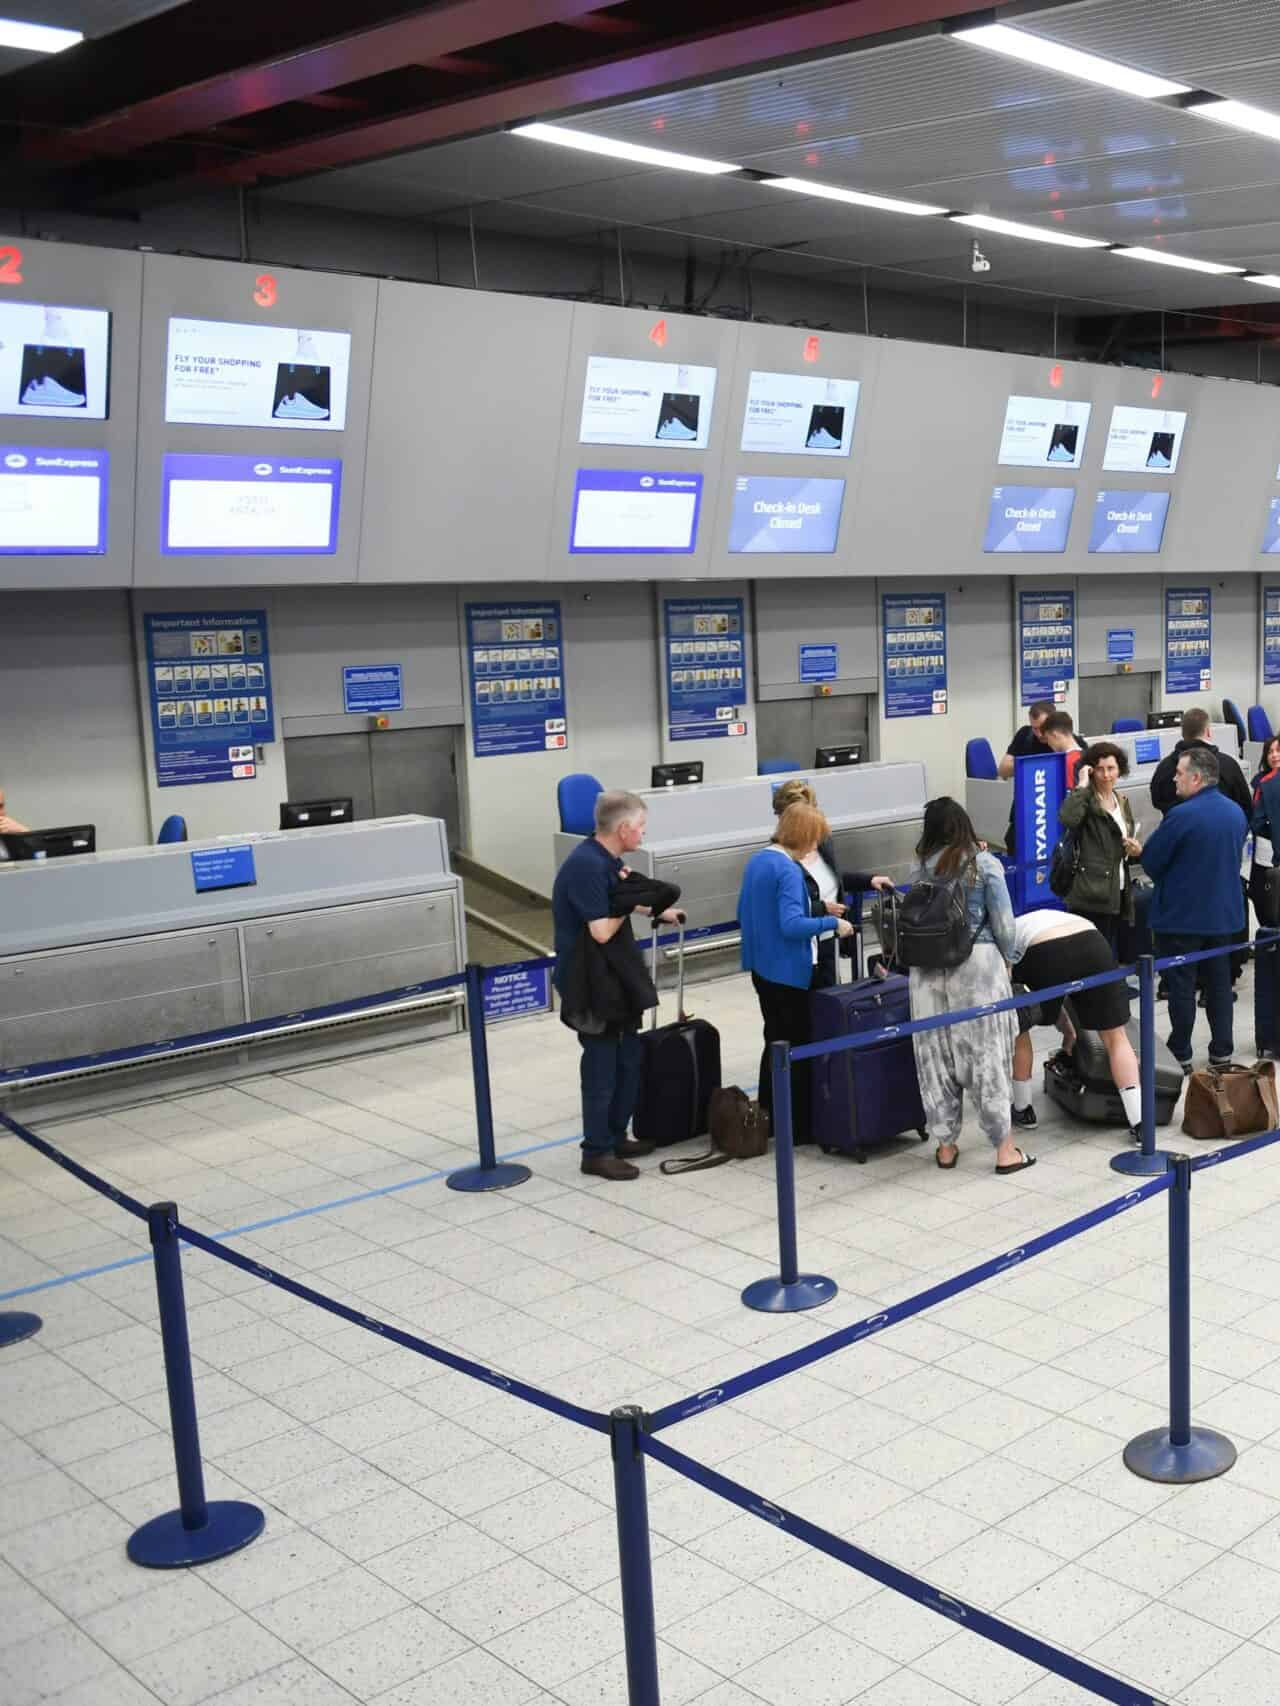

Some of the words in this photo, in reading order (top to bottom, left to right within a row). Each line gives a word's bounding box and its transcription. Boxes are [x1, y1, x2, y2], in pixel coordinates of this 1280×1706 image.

[0, 246, 23, 284] 2
[252, 274, 278, 307] 3
[649, 319, 667, 348] 4
[174, 354, 189, 362] FLY
[192, 356, 216, 365] YOUR
[218, 358, 262, 369] SHOPPING
[174, 365, 191, 373] FOR
[35, 457, 99, 468] SunExpress
[279, 465, 332, 475] SunExpress
[471, 608, 509, 617] Important
[151, 617, 201, 629] Important
[203, 614, 259, 626] Information
[1035, 768, 1048, 862] RYANAIR
[494, 971, 528, 985] NOTICE
